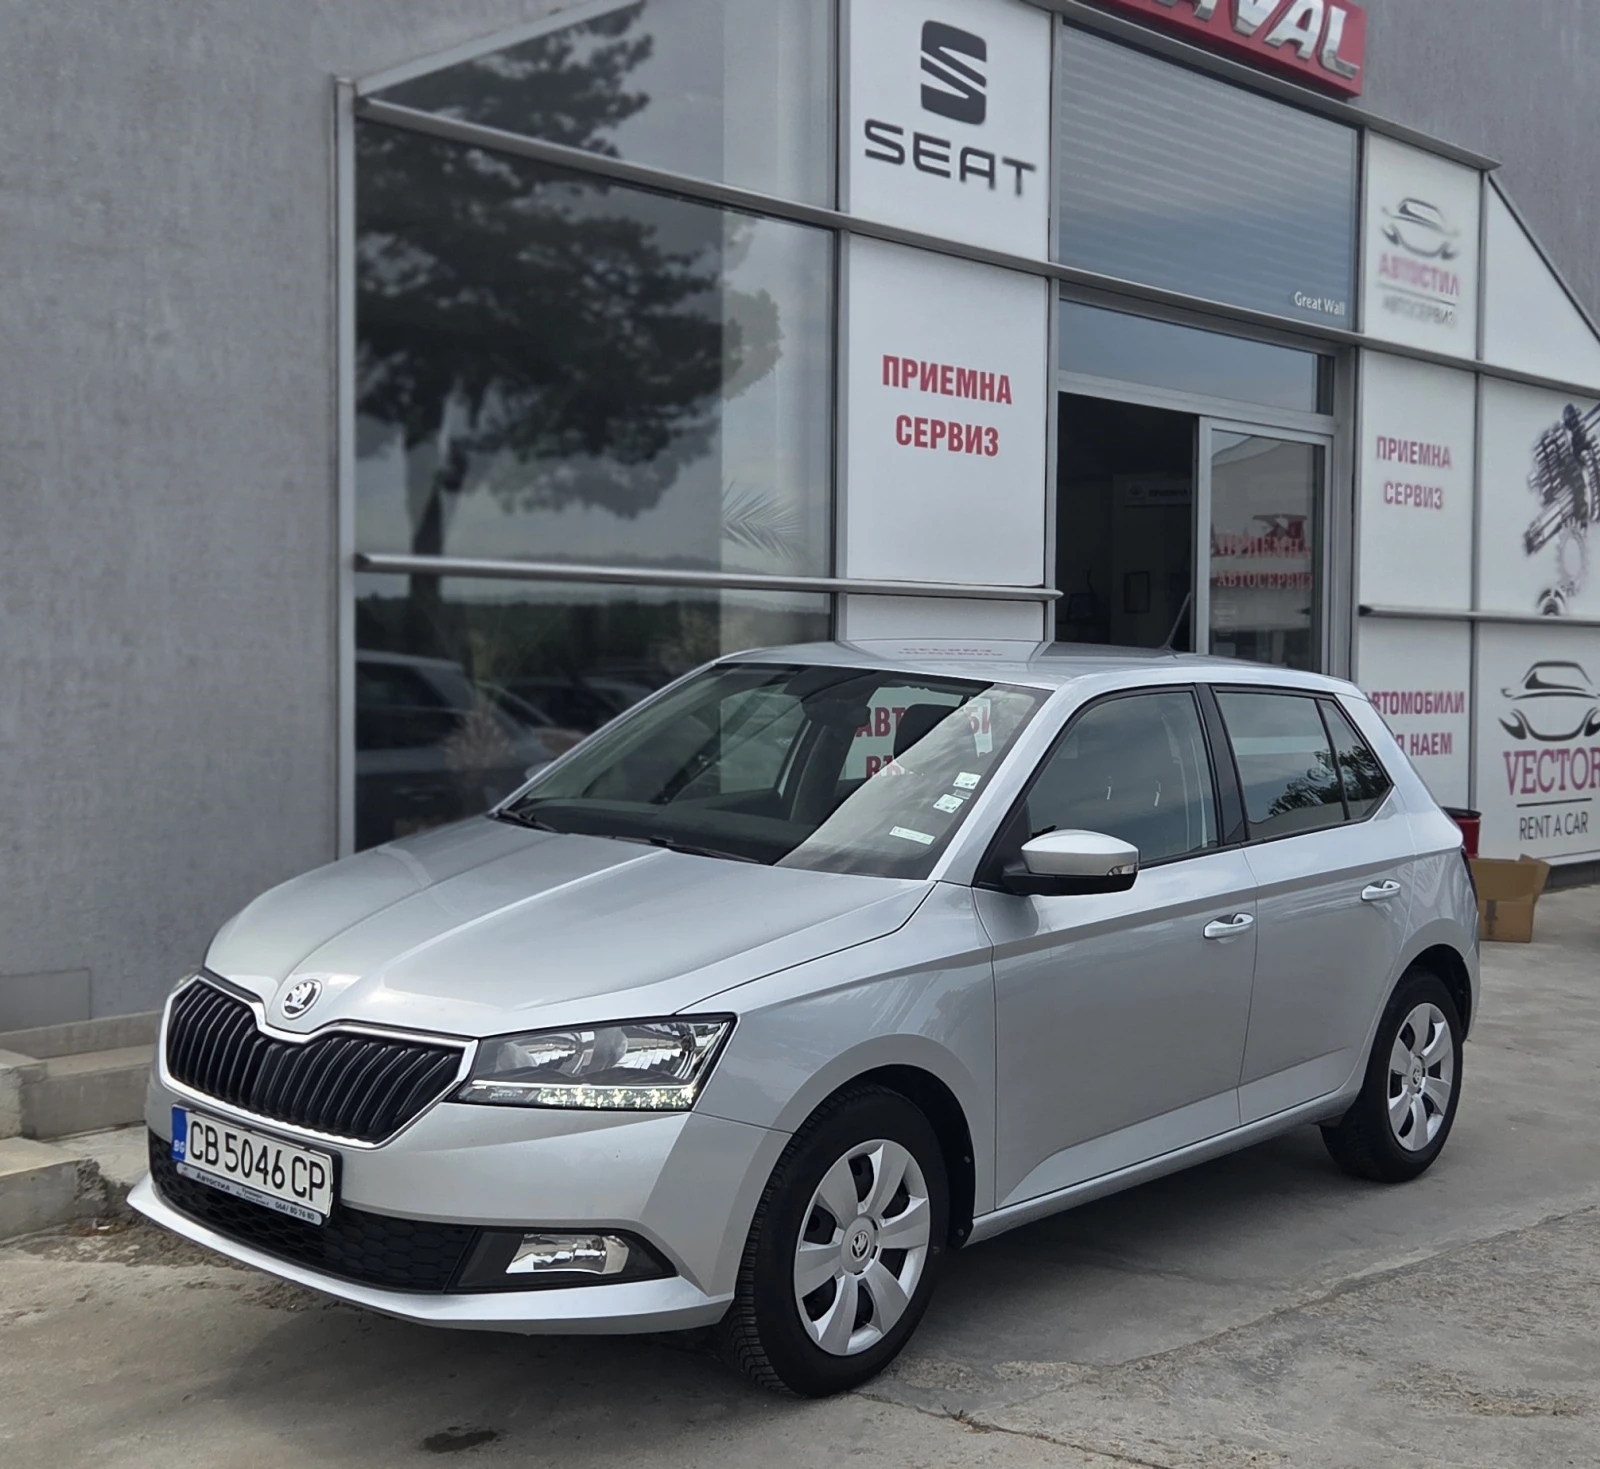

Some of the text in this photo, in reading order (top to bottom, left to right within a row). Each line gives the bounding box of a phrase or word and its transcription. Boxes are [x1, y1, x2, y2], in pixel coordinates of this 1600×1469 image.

[865, 119, 1036, 196] SEAT
[1294, 290, 1346, 316] Great Wall
[883, 354, 1012, 405] ПРИЕМНА
[896, 414, 999, 457] СЕРВИЗ
[1377, 435, 1452, 469] ПРИЕМНА
[1384, 481, 1443, 510] СЕРВИЗ
[1367, 691, 1464, 715] ВТОМОБИЛИ
[1410, 732, 1452, 756] НАЕМ
[1519, 811, 1588, 841] RENT A CAR
[174, 1139, 185, 1153] BG
[224, 1132, 286, 1190] 5046
